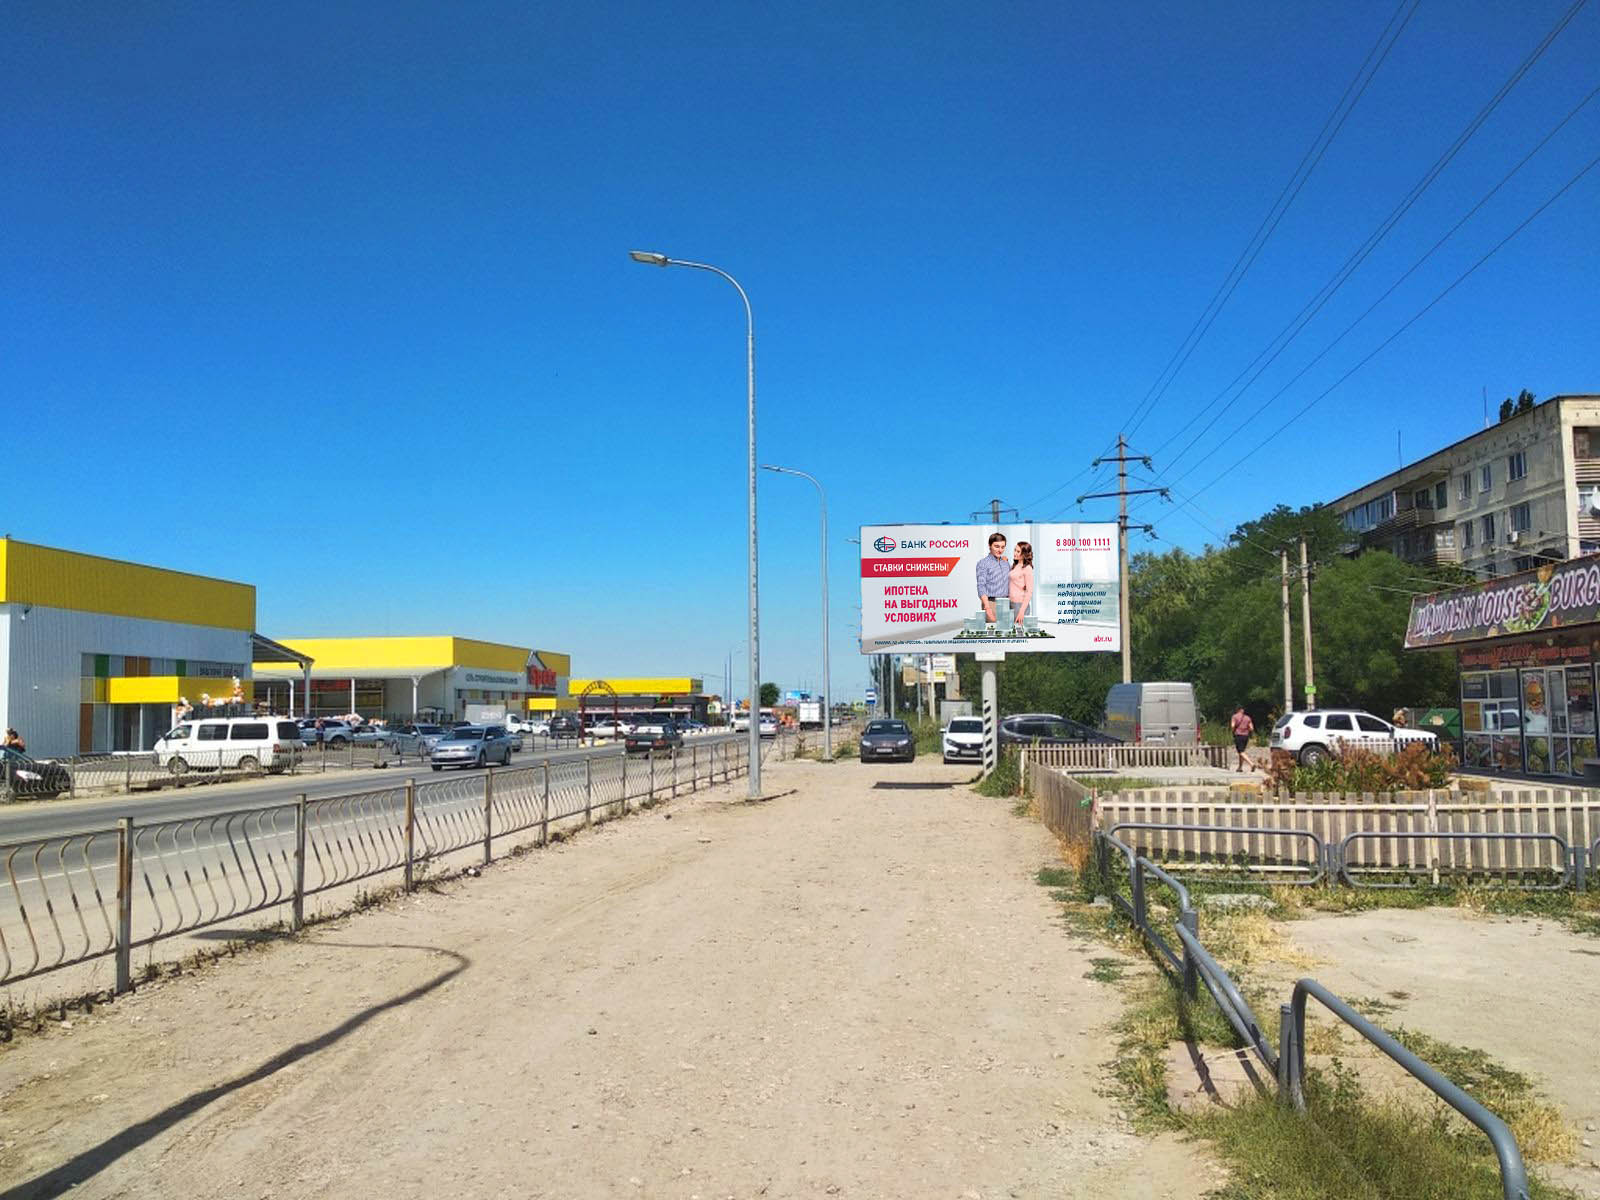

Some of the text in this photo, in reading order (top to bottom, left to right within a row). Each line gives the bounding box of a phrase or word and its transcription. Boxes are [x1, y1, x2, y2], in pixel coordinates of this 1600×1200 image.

[901, 539, 969, 549] БАНК РОССИЯ
[1056, 538, 1110, 547] 8 800 100 1111
[873, 562, 949, 572] СТАВКИ СНИЖЕНЫ!
[884, 586, 929, 596] ИПОТЕКА
[1474, 586, 1523, 627] HOUSE
[1549, 564, 1600, 612] BURG
[884, 599, 958, 610] НА ВЫГОДНЫХ
[884, 612, 936, 623] УСЛОВИЯХ
[1093, 635, 1112, 643] abr.ru
